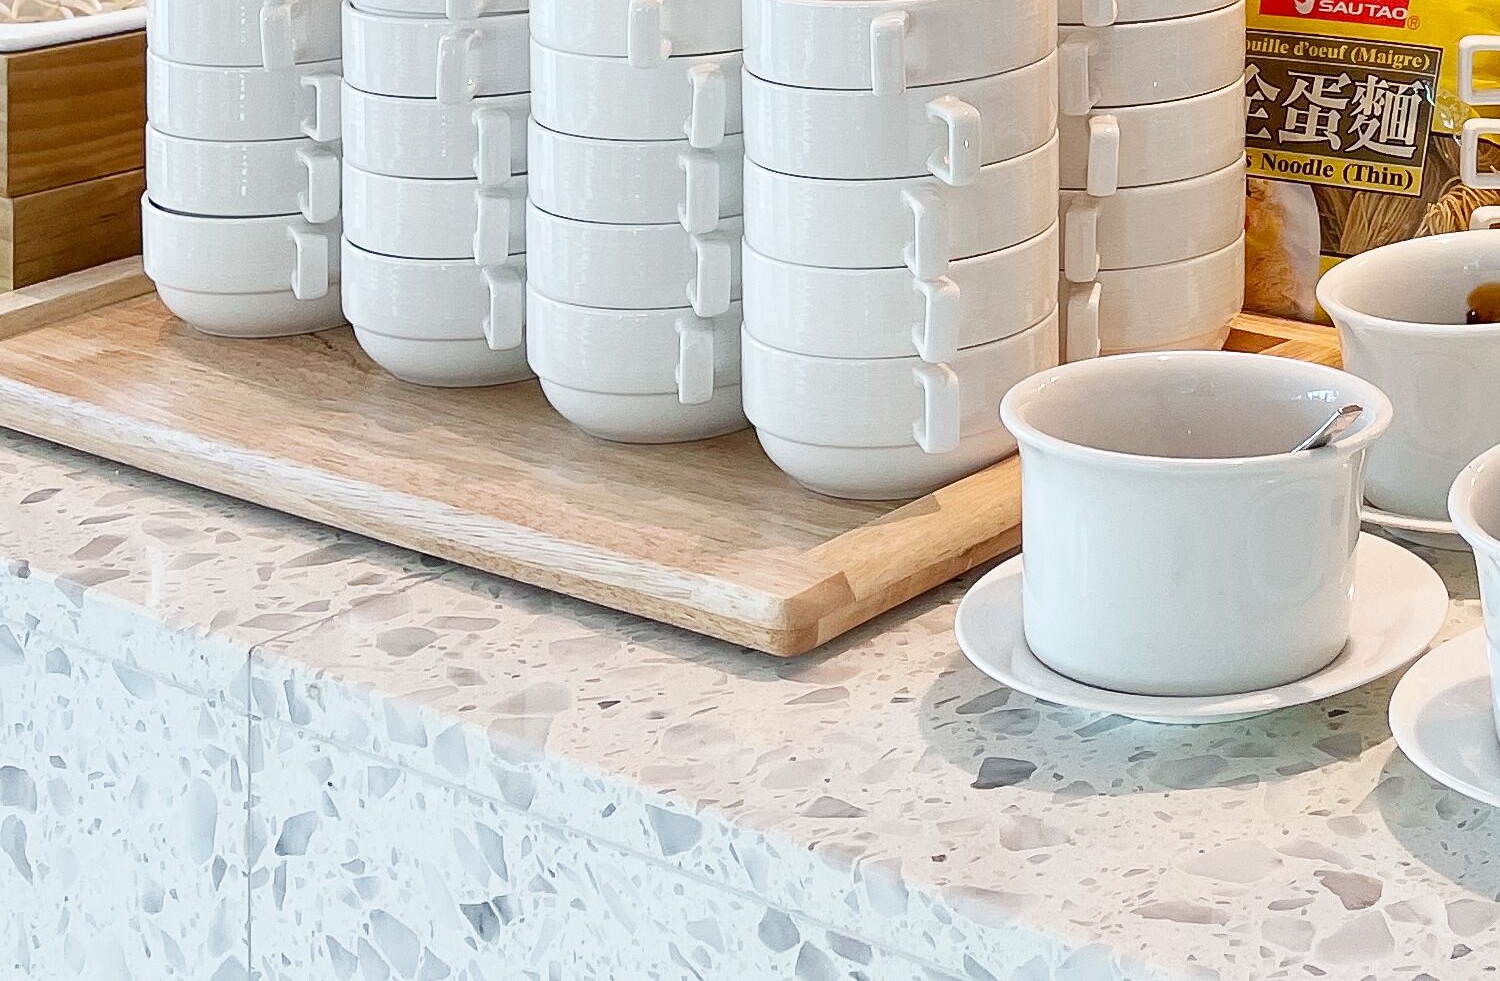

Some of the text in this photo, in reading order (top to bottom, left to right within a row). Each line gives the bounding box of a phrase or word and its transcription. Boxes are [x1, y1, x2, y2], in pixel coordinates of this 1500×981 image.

[1318, 0, 1408, 21] SAUTAO
[1293, 40, 1348, 60] d'oeuf
[1351, 46, 1431, 69] (Maigre)
[1261, 153, 1335, 179] Noodle
[1343, 163, 1414, 190] (Thin)
